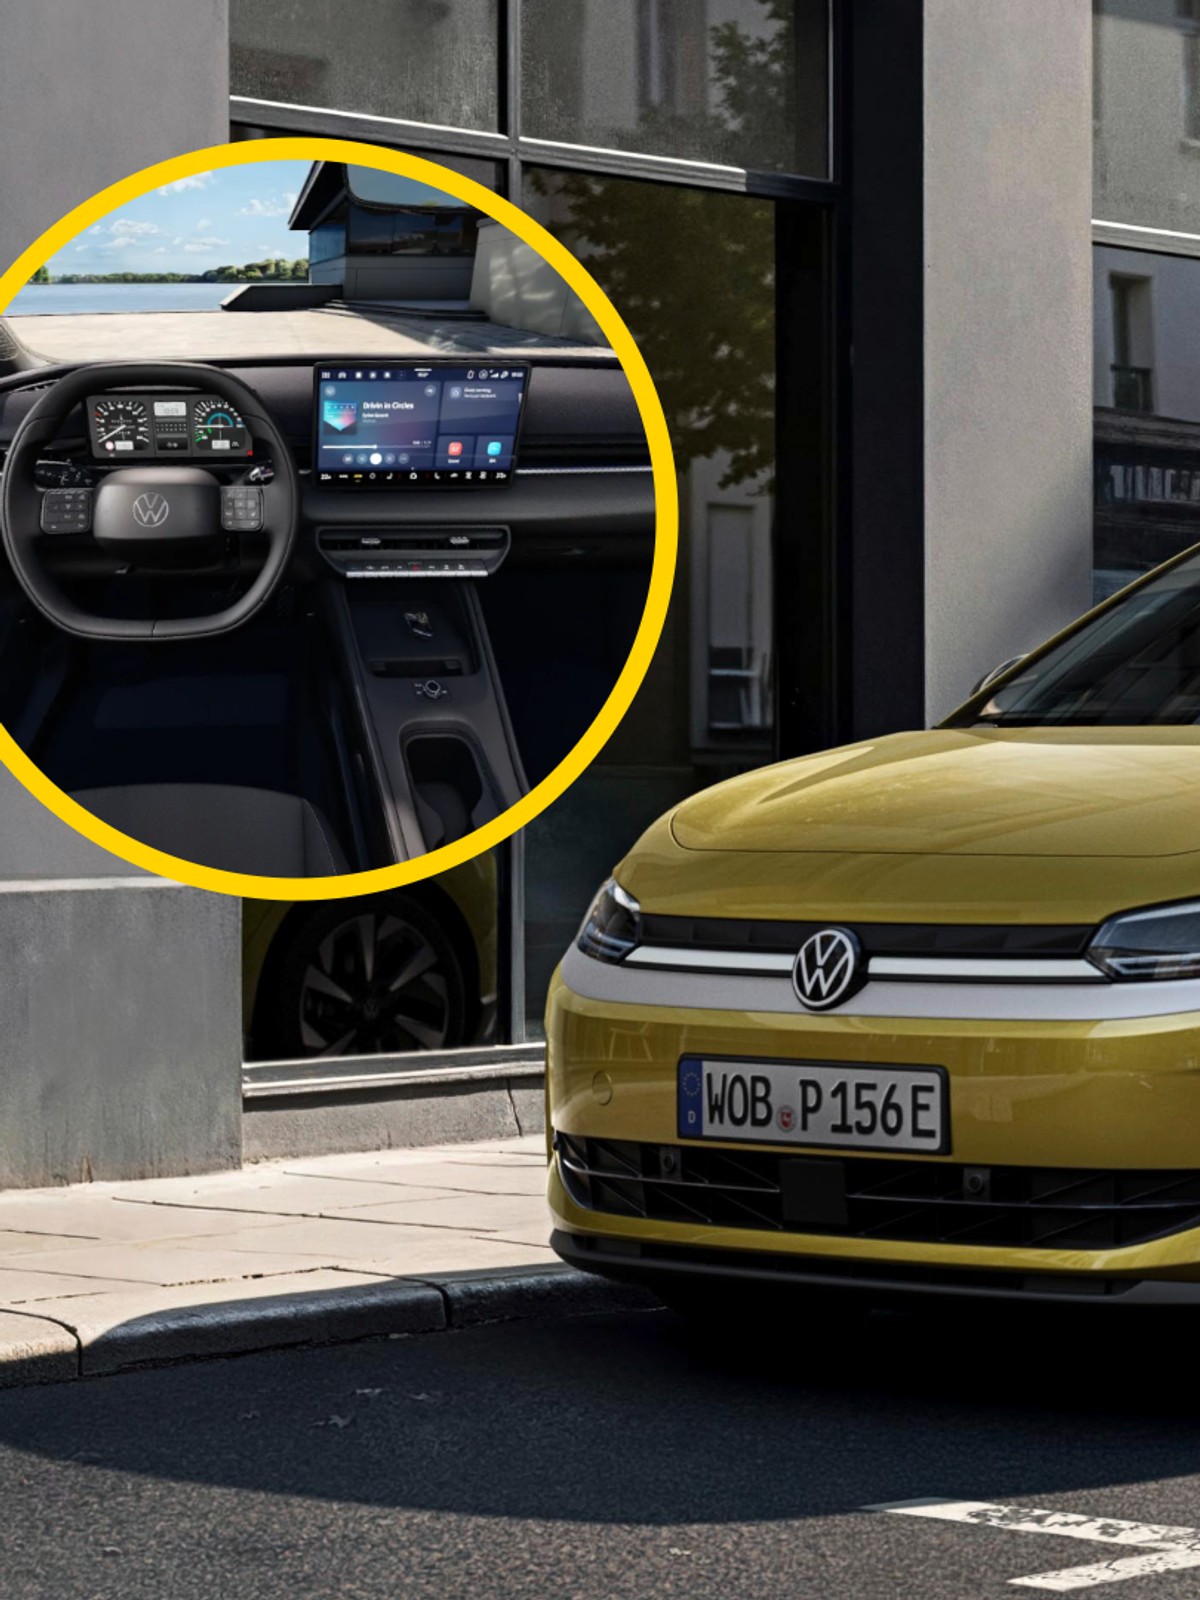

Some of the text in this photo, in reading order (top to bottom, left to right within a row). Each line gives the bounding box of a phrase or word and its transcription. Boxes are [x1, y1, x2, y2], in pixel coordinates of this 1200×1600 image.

[792, 929, 856, 1008] VW
[687, 1110, 696, 1124] D
[706, 1072, 773, 1128] WOB
